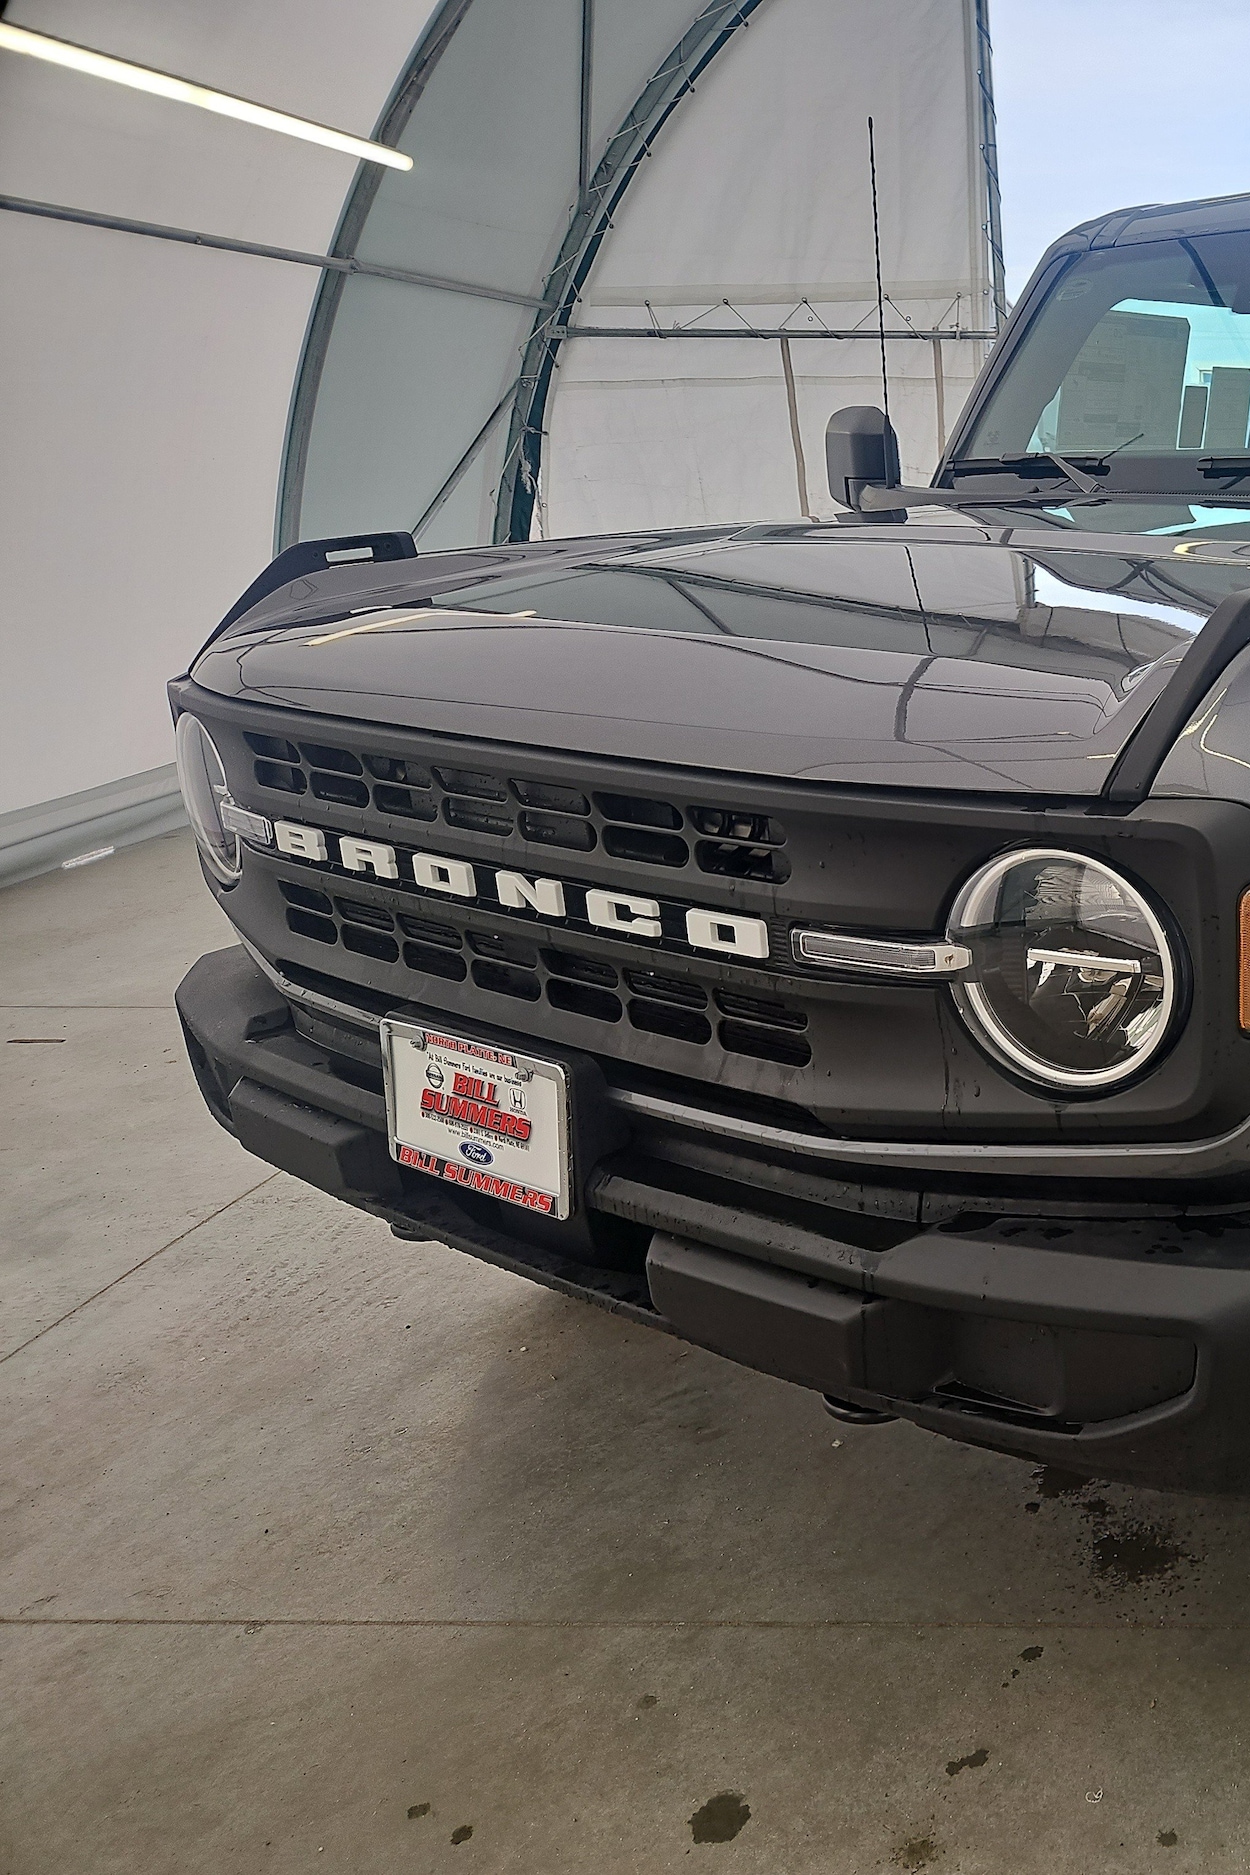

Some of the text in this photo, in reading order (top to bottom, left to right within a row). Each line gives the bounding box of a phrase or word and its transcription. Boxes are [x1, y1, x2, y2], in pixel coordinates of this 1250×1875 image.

[276, 820, 770, 959] BRONCO
[425, 1032, 457, 1051] NORTH
[498, 1053, 512, 1066] NE
[420, 1088, 531, 1140] SUMMERS
[452, 1072, 499, 1106] BILL
[399, 1145, 553, 1212] BILL SUMMERS
